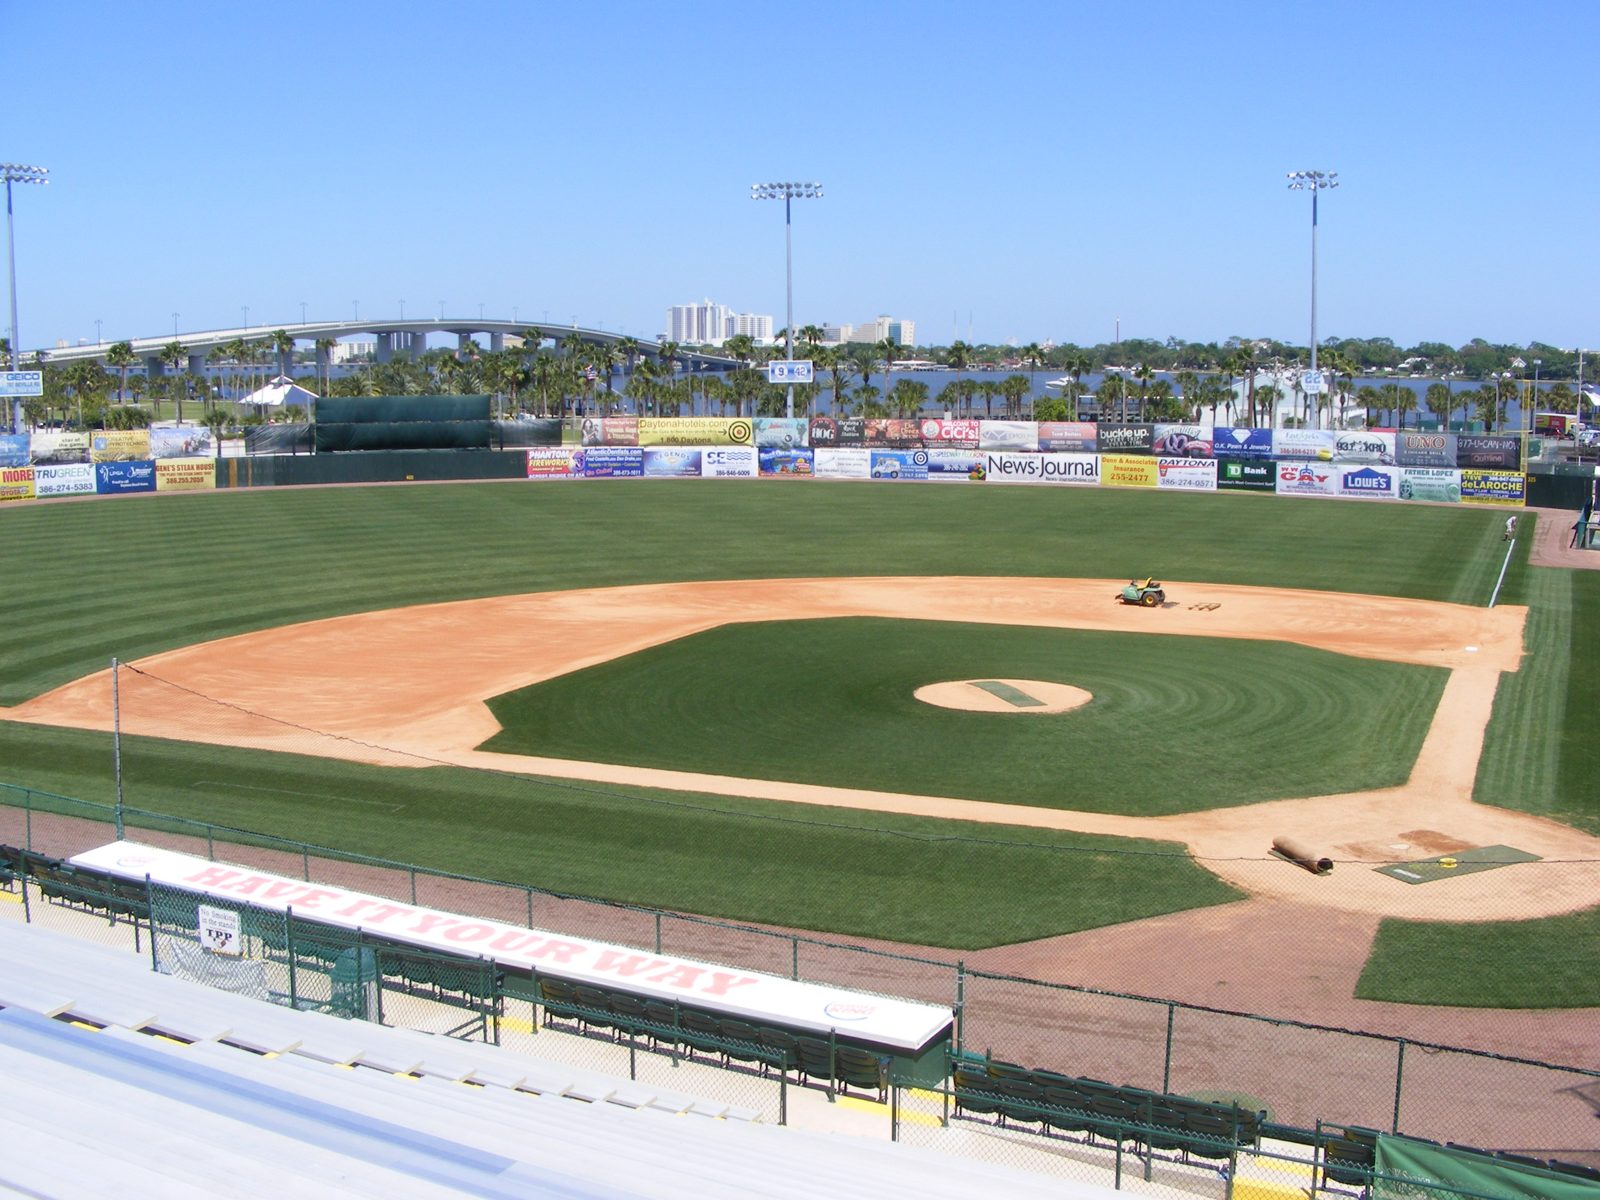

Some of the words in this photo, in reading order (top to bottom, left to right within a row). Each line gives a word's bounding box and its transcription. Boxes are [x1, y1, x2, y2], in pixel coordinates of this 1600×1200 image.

[778, 367, 785, 376] 9
[795, 367, 805, 376] 42
[7, 373, 40, 381] GEICO
[1305, 372, 1321, 384] 22
[640, 419, 728, 428] DaytonaHotels.com
[811, 428, 834, 439] HOG
[1100, 428, 1133, 439] buckle
[1134, 428, 1149, 438] up.
[1406, 436, 1446, 449] UNO
[528, 450, 569, 459] PHANTOM
[654, 451, 690, 461] LEGENDS
[528, 459, 569, 467] FIREWORKS
[1159, 459, 1215, 467] DAYTONA
[2, 469, 35, 483] MORE!
[36, 467, 90, 480] TRUGREEN
[1230, 466, 1241, 476] TD
[1244, 466, 1267, 475] Bank
[1110, 473, 1149, 481] 255-2477
[39, 483, 94, 493] 386-274-5383
[1461, 480, 1523, 491] deLAROCHE
[184, 866, 343, 909] HAVE
[336, 899, 414, 925] IT
[409, 912, 589, 964] YOUR
[592, 950, 761, 995] WAY
[206, 928, 233, 942] TPP
